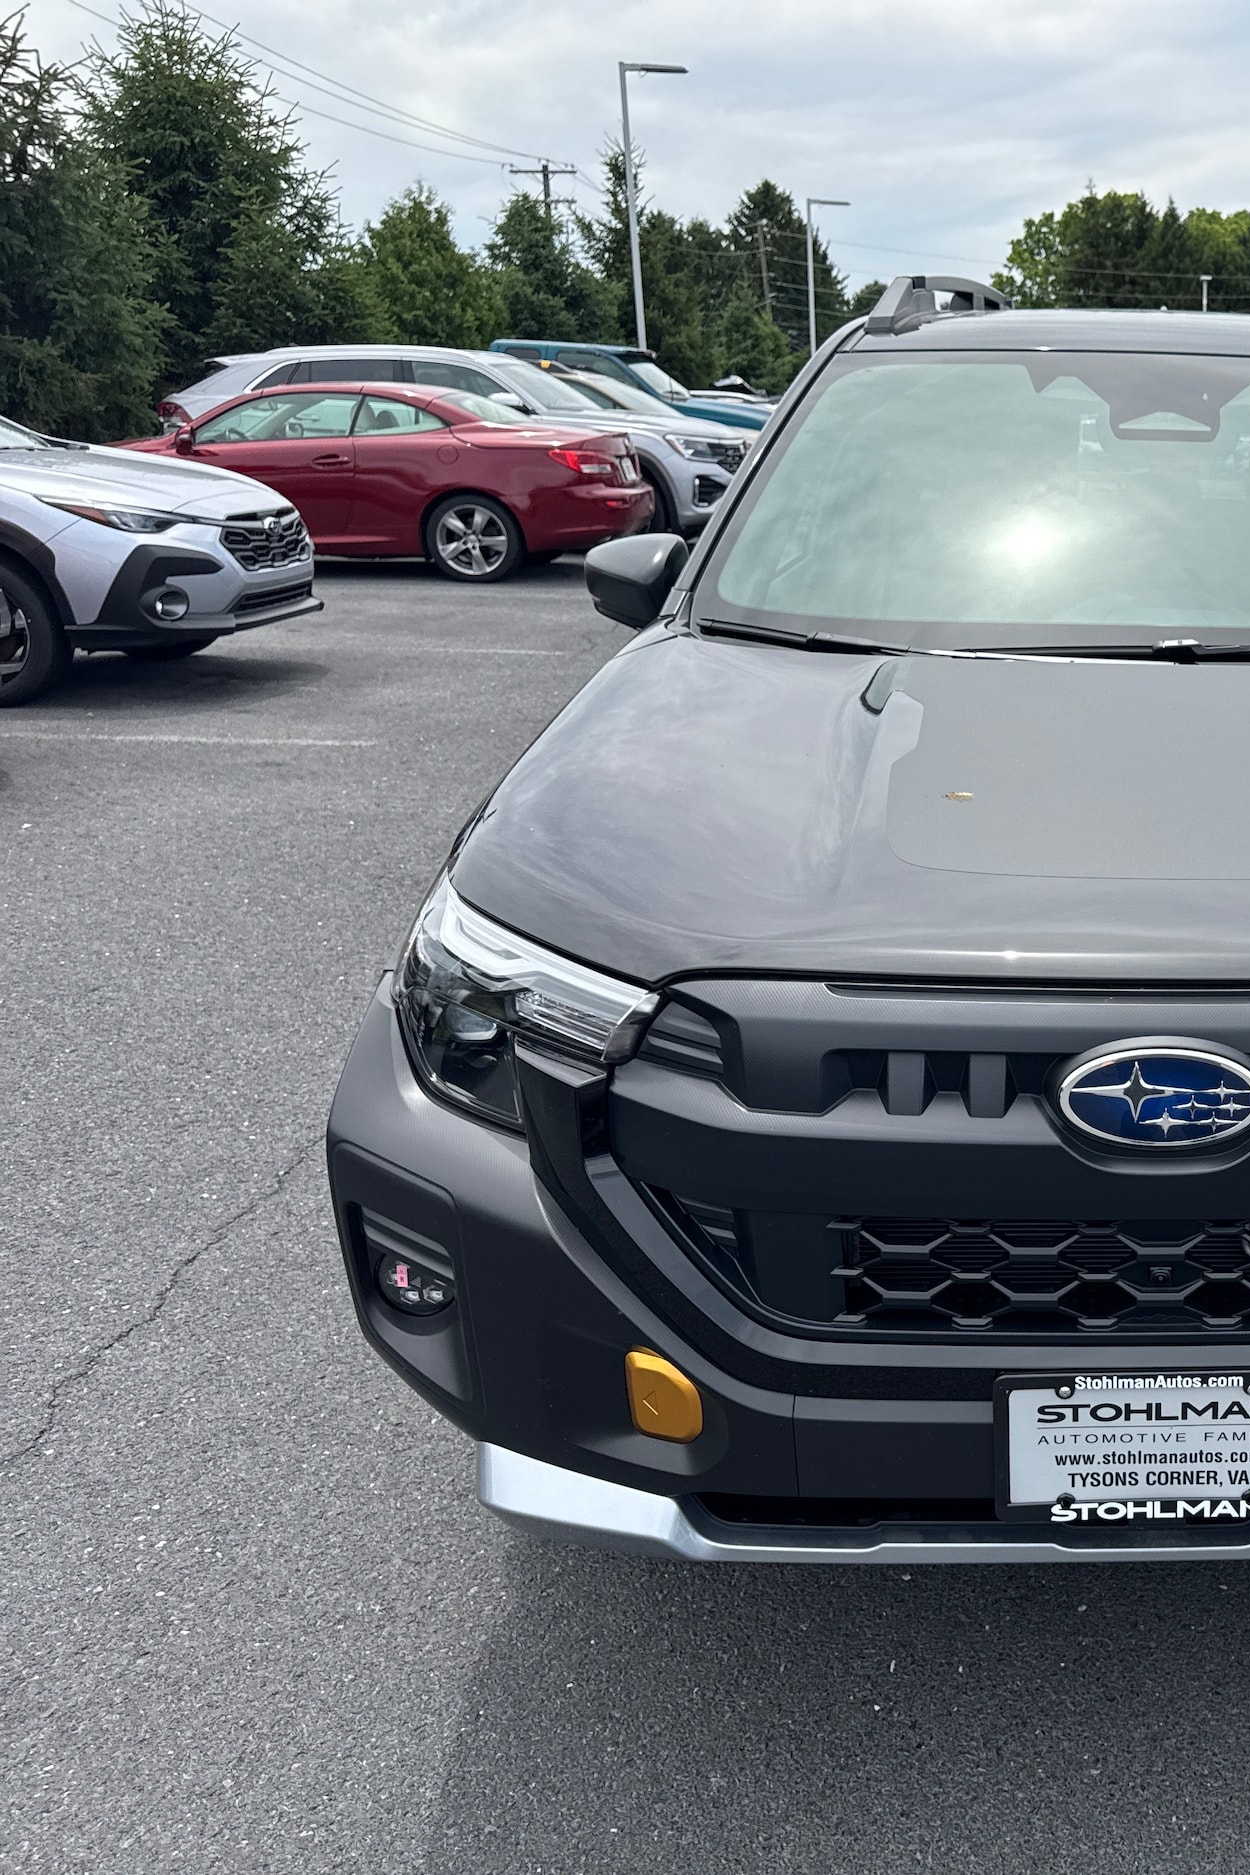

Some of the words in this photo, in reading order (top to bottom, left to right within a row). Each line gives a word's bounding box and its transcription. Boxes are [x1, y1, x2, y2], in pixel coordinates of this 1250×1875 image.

[1074, 1375, 1244, 1391] StohlmanAutos.com
[1037, 1432, 1187, 1446] AUTOMOTIVE
[1067, 1471, 1139, 1488] TYSONS
[1145, 1470, 1223, 1488] CORNER,
[1227, 1470, 1250, 1485] VA
